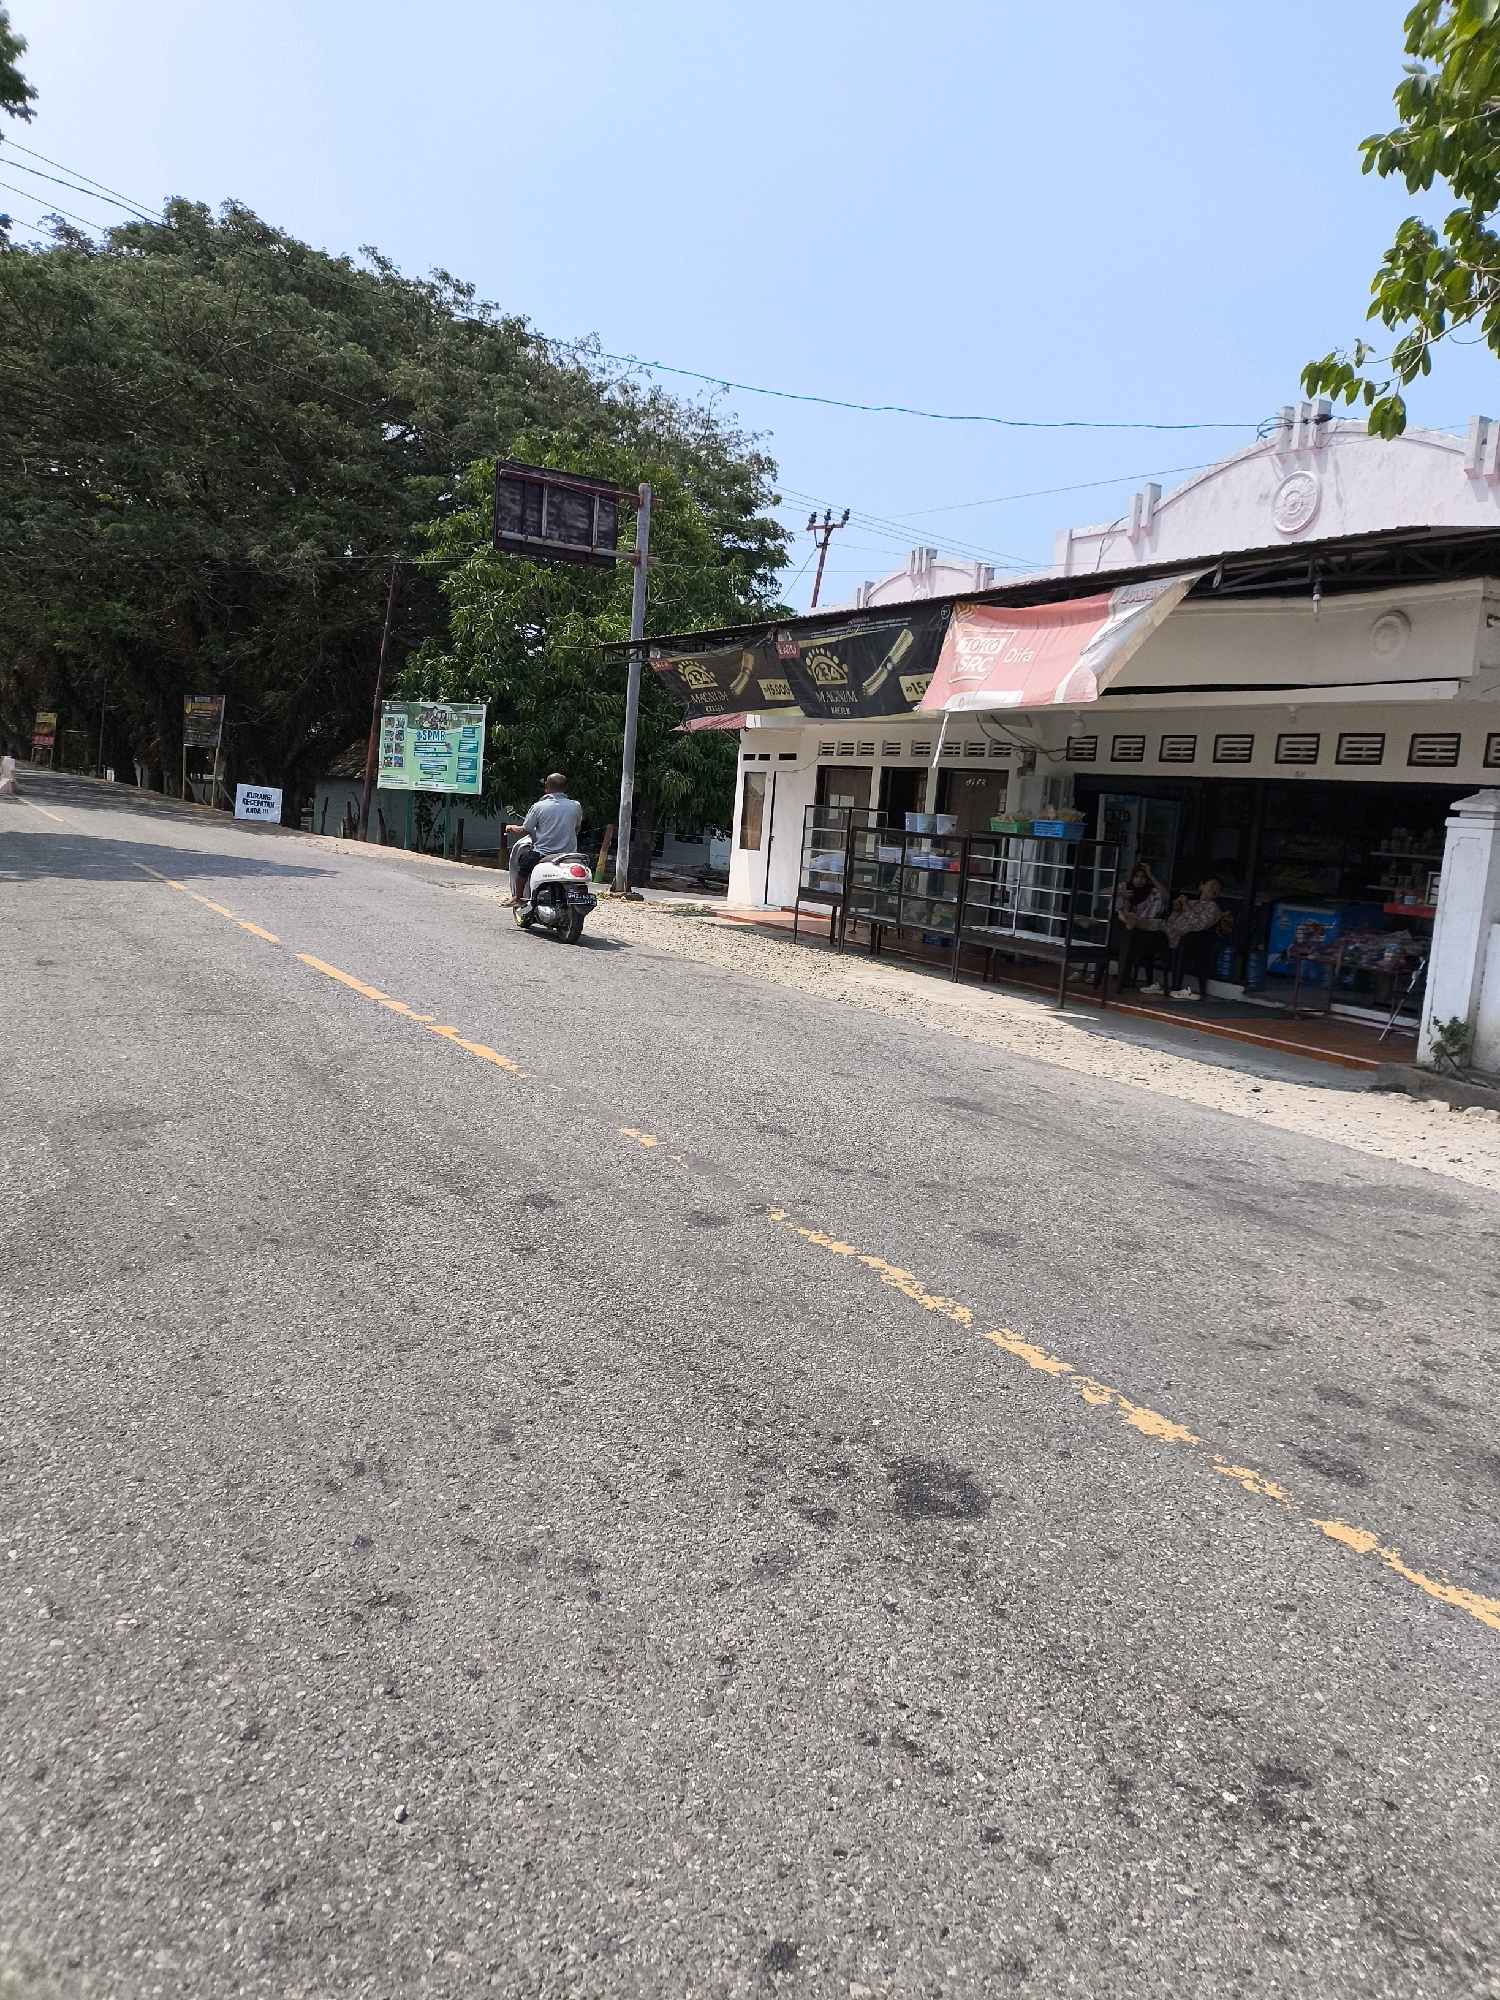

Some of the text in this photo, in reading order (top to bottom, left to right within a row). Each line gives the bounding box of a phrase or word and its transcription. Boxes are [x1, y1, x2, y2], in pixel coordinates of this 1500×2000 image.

[963, 638, 1001, 653] TOKO
[1003, 647, 1034, 664] Difa
[957, 655, 995, 673] SRC
[689, 670, 711, 685] 234
[815, 663, 842, 681] 234
[690, 690, 729, 704] MAGNUM
[814, 689, 859, 703] MAGNUM
[246, 792, 273, 801] KURANGI
